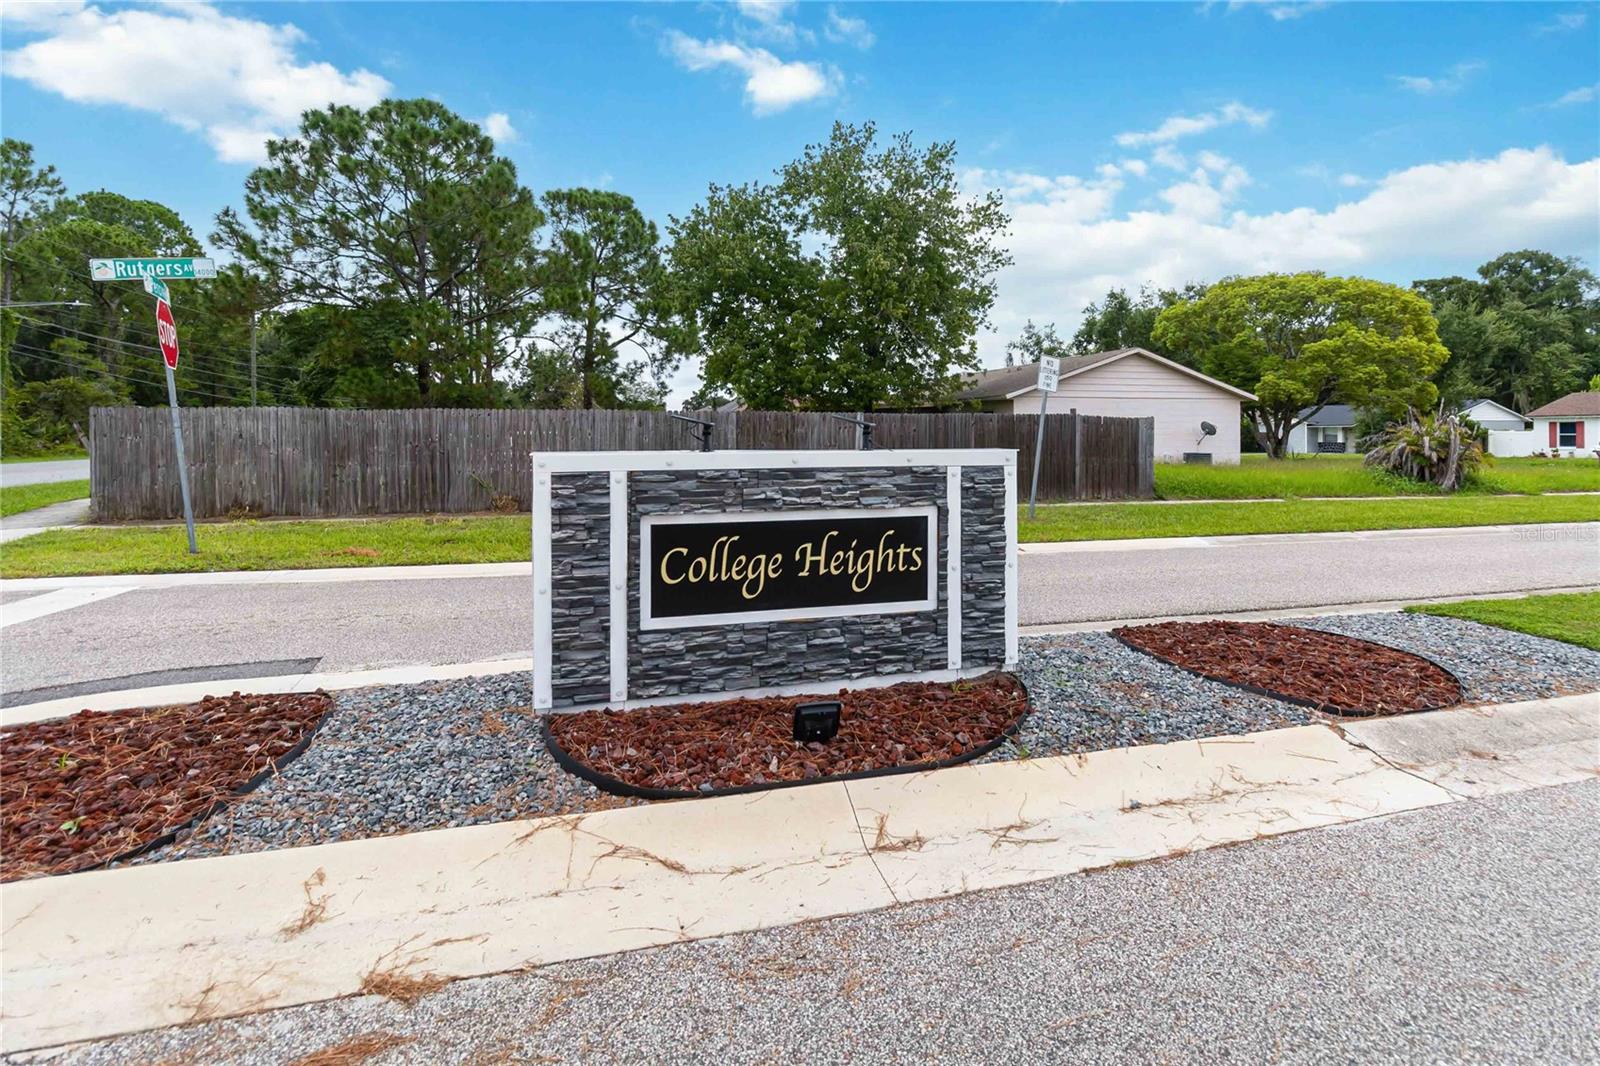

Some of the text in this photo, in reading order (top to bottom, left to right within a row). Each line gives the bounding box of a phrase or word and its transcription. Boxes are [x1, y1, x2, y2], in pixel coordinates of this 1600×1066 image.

[115, 261, 183, 277] Rutgers
[159, 319, 176, 349] STOP
[660, 529, 923, 600] College Heights
